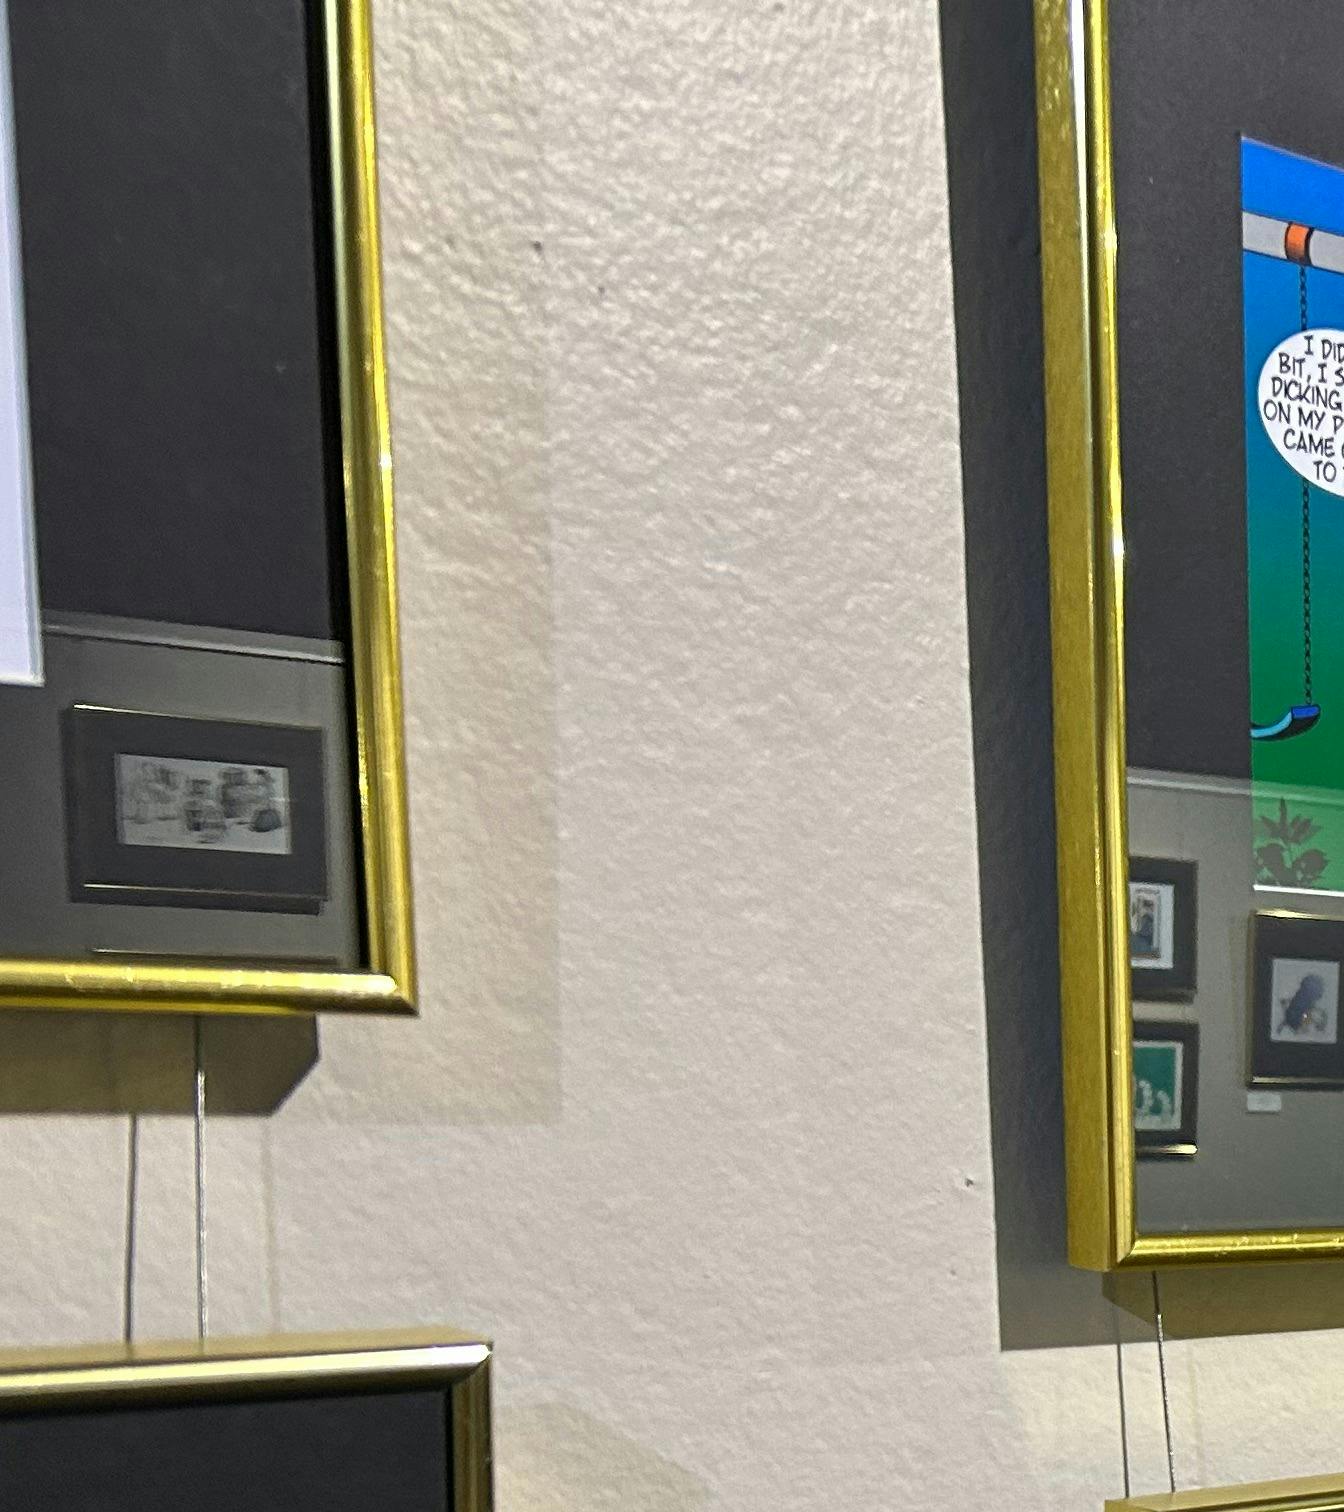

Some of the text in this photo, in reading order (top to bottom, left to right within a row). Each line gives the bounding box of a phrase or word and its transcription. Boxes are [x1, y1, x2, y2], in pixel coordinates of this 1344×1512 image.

[1304, 335, 1314, 355] I
[1278, 352, 1312, 383] BIT,
[1318, 363, 1328, 383] I
[1271, 376, 1342, 412] DICKING
[1264, 399, 1291, 424] ON
[1298, 406, 1325, 430] MY
[1283, 428, 1335, 458] CAME
[1313, 460, 1337, 482] TO
